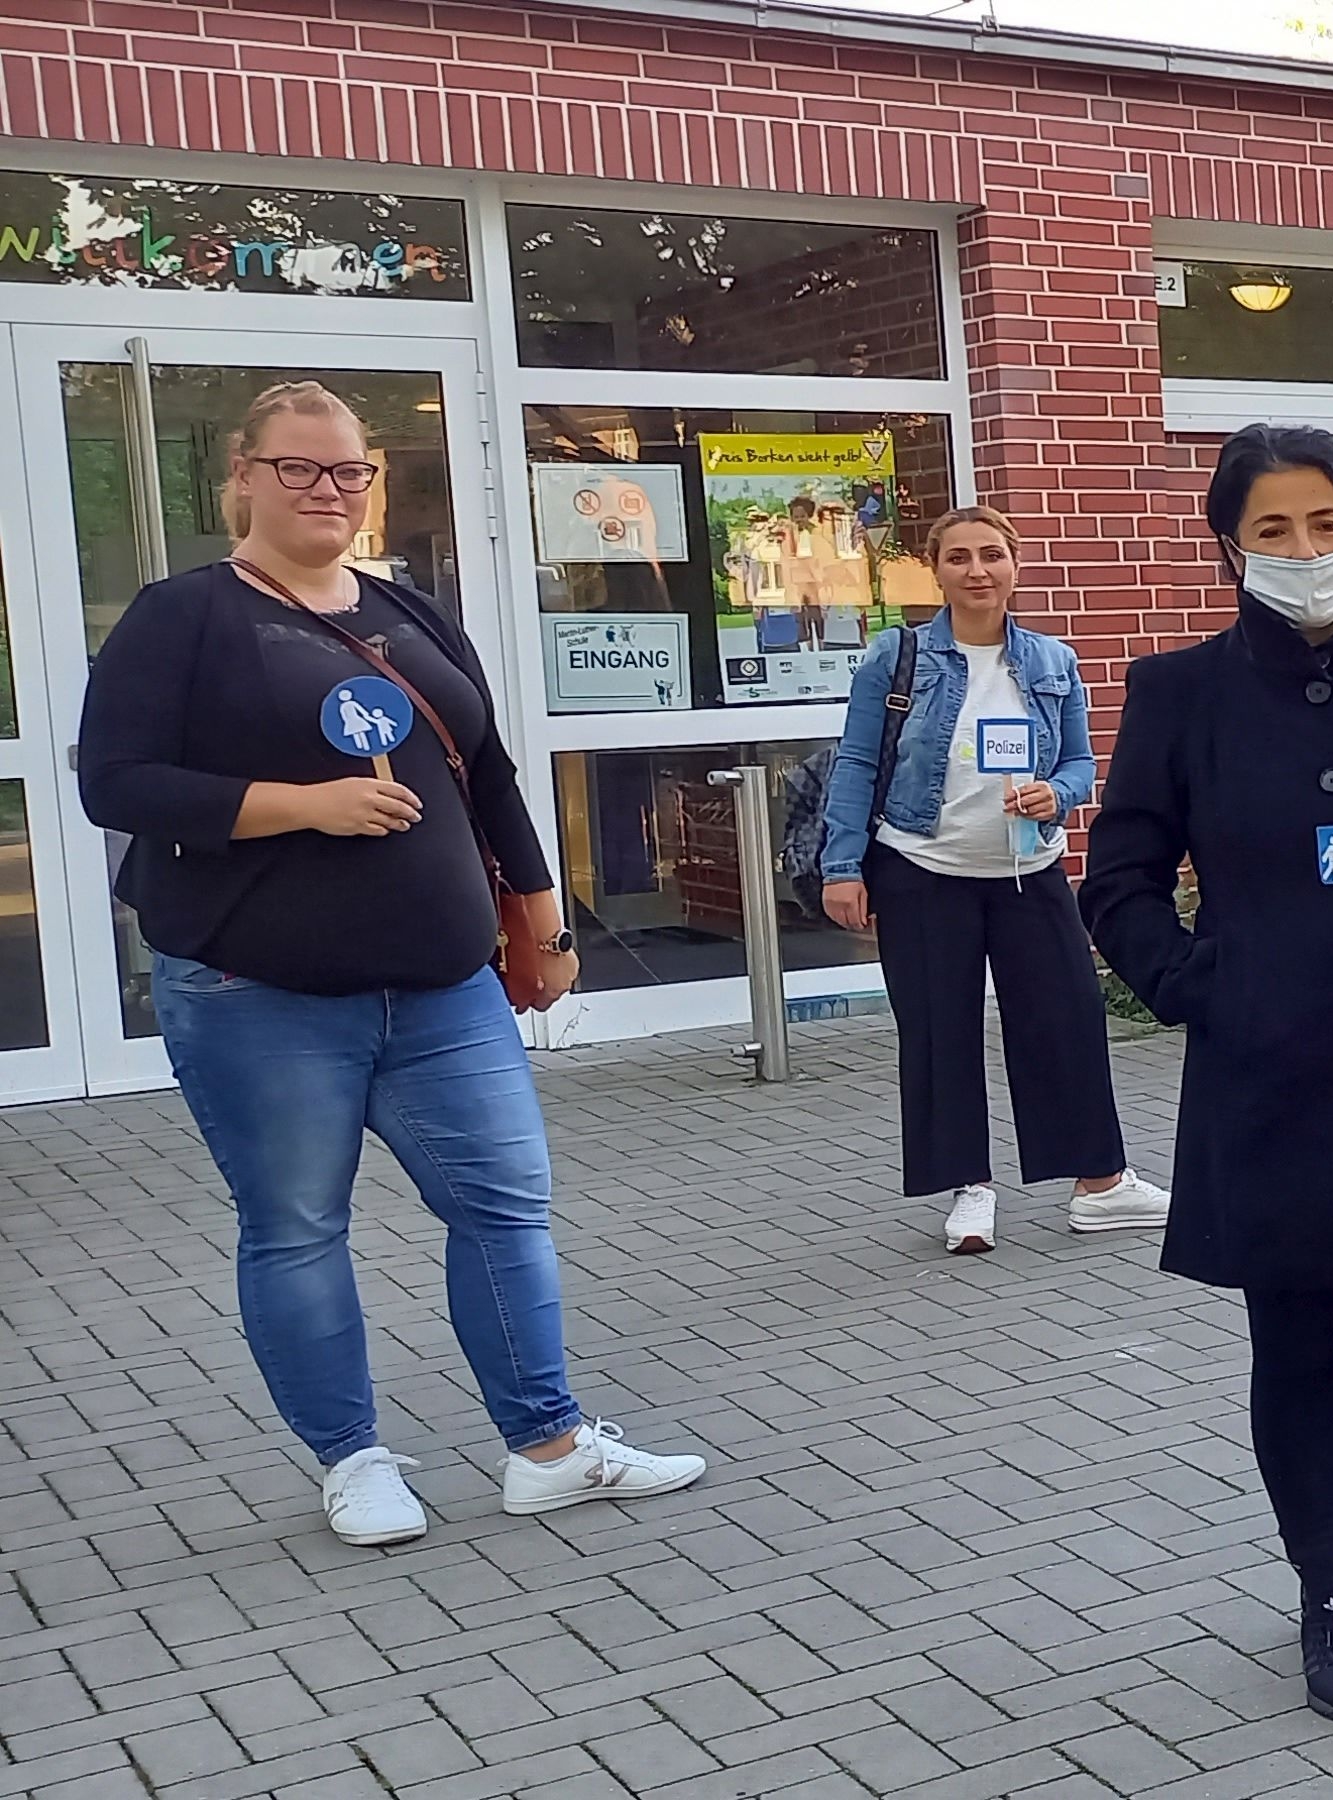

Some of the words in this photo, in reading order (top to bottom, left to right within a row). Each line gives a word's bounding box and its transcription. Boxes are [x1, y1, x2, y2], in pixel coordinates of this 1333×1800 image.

[0, 205, 449, 284] wikomen
[747, 449, 794, 463] Borken
[797, 449, 831, 463] sieht
[569, 650, 670, 669] EINGANG
[986, 739, 1026, 755] Polizei
